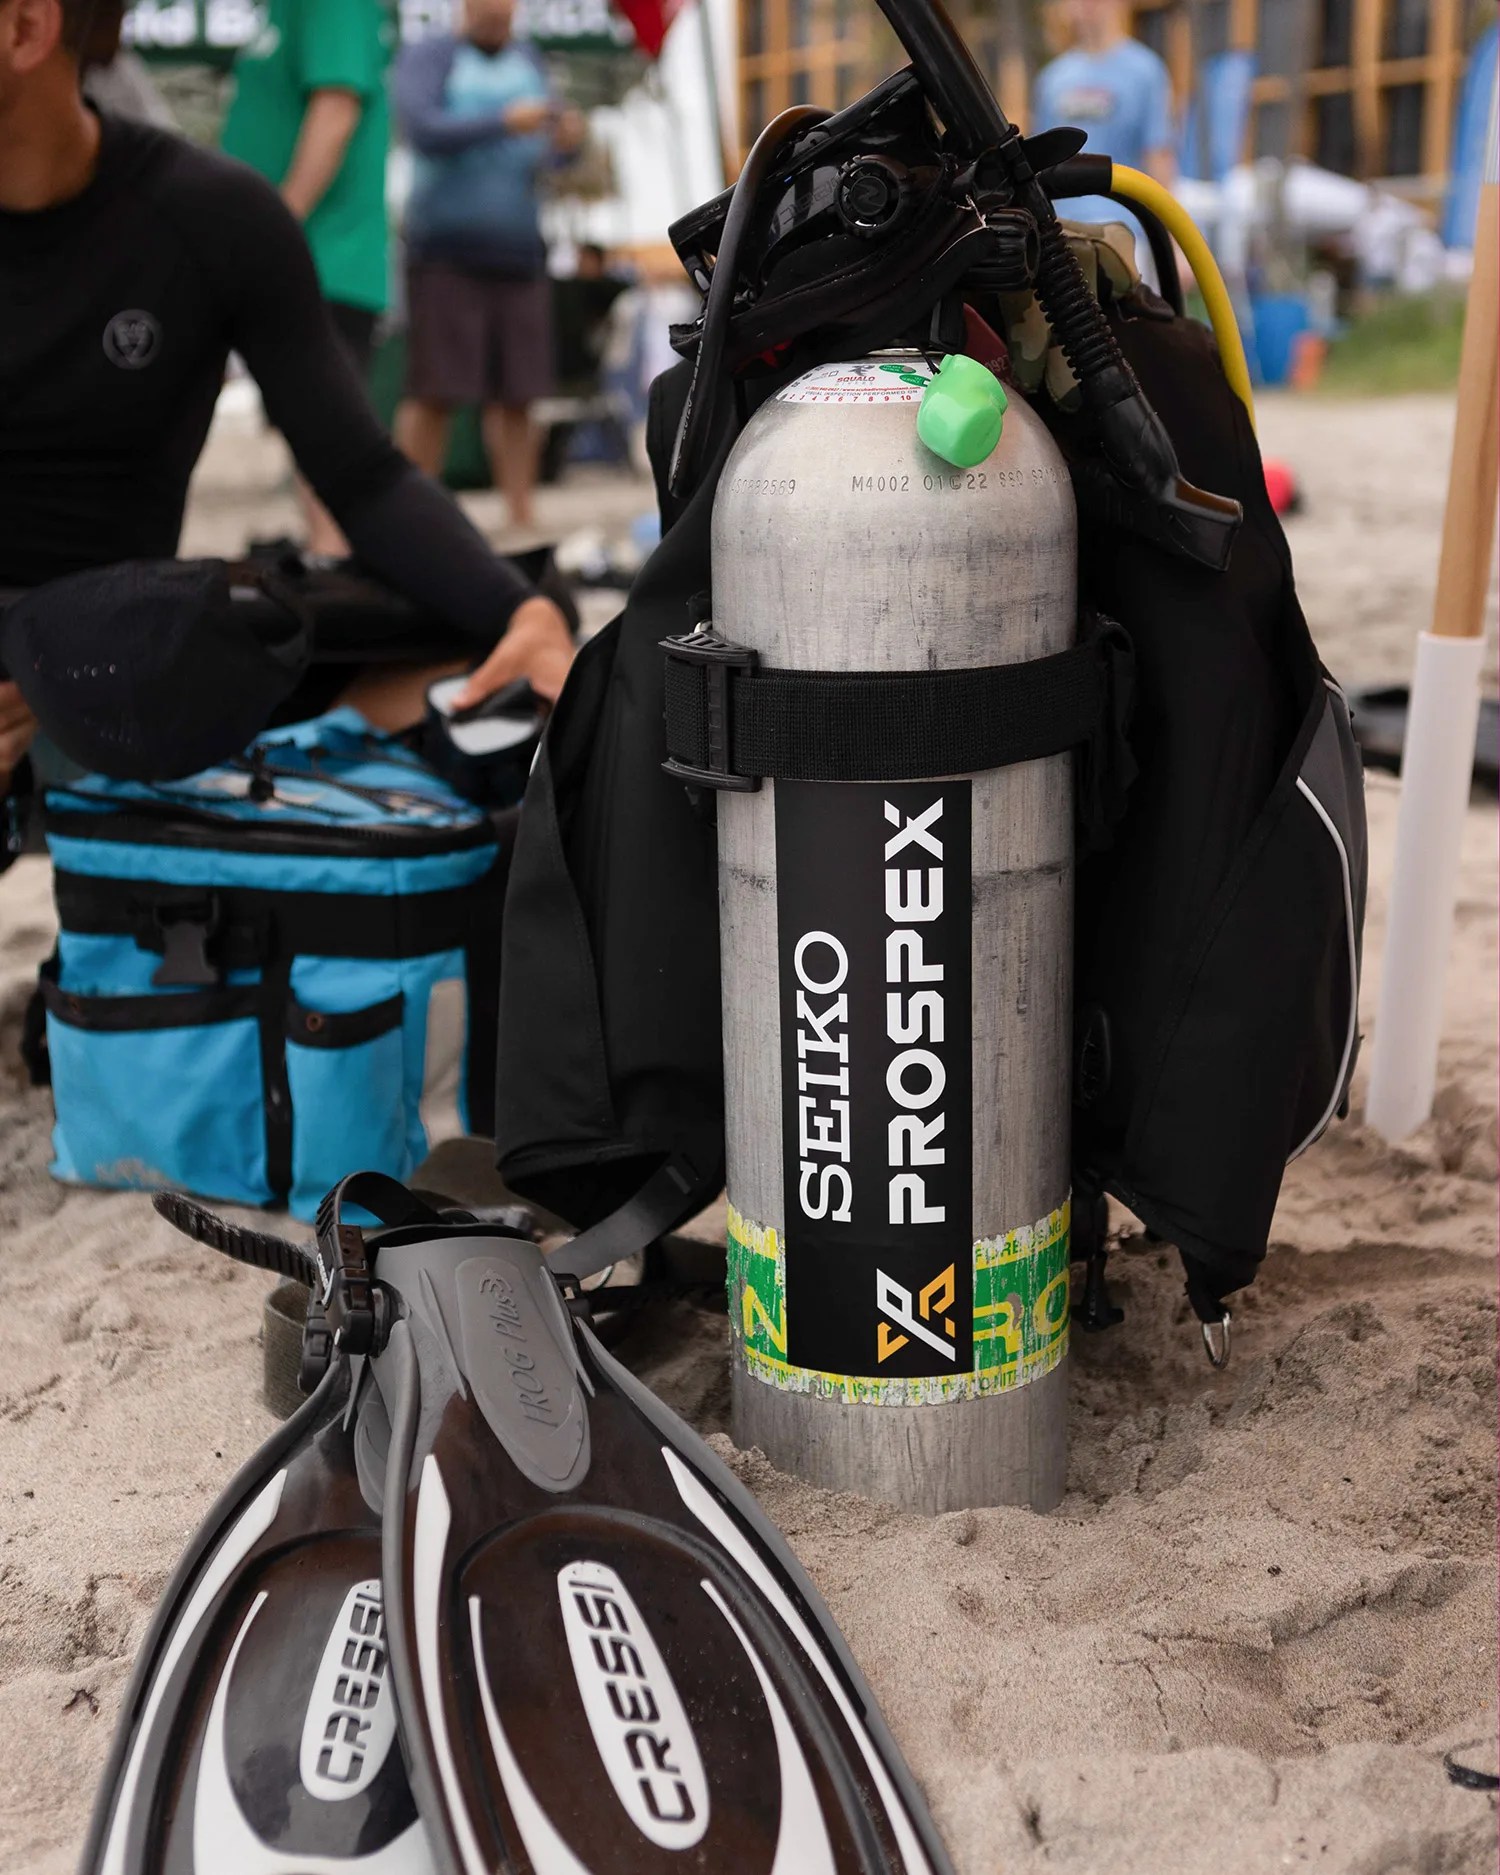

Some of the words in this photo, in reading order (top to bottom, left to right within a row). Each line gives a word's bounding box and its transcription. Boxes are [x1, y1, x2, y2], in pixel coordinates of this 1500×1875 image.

[851, 475, 910, 492] M4002
[794, 930, 853, 1223] SEIKO
[884, 796, 947, 1225] PROSPEX
[315, 1592, 388, 1784] CRESSI
[569, 1579, 696, 1825] CRESSI
